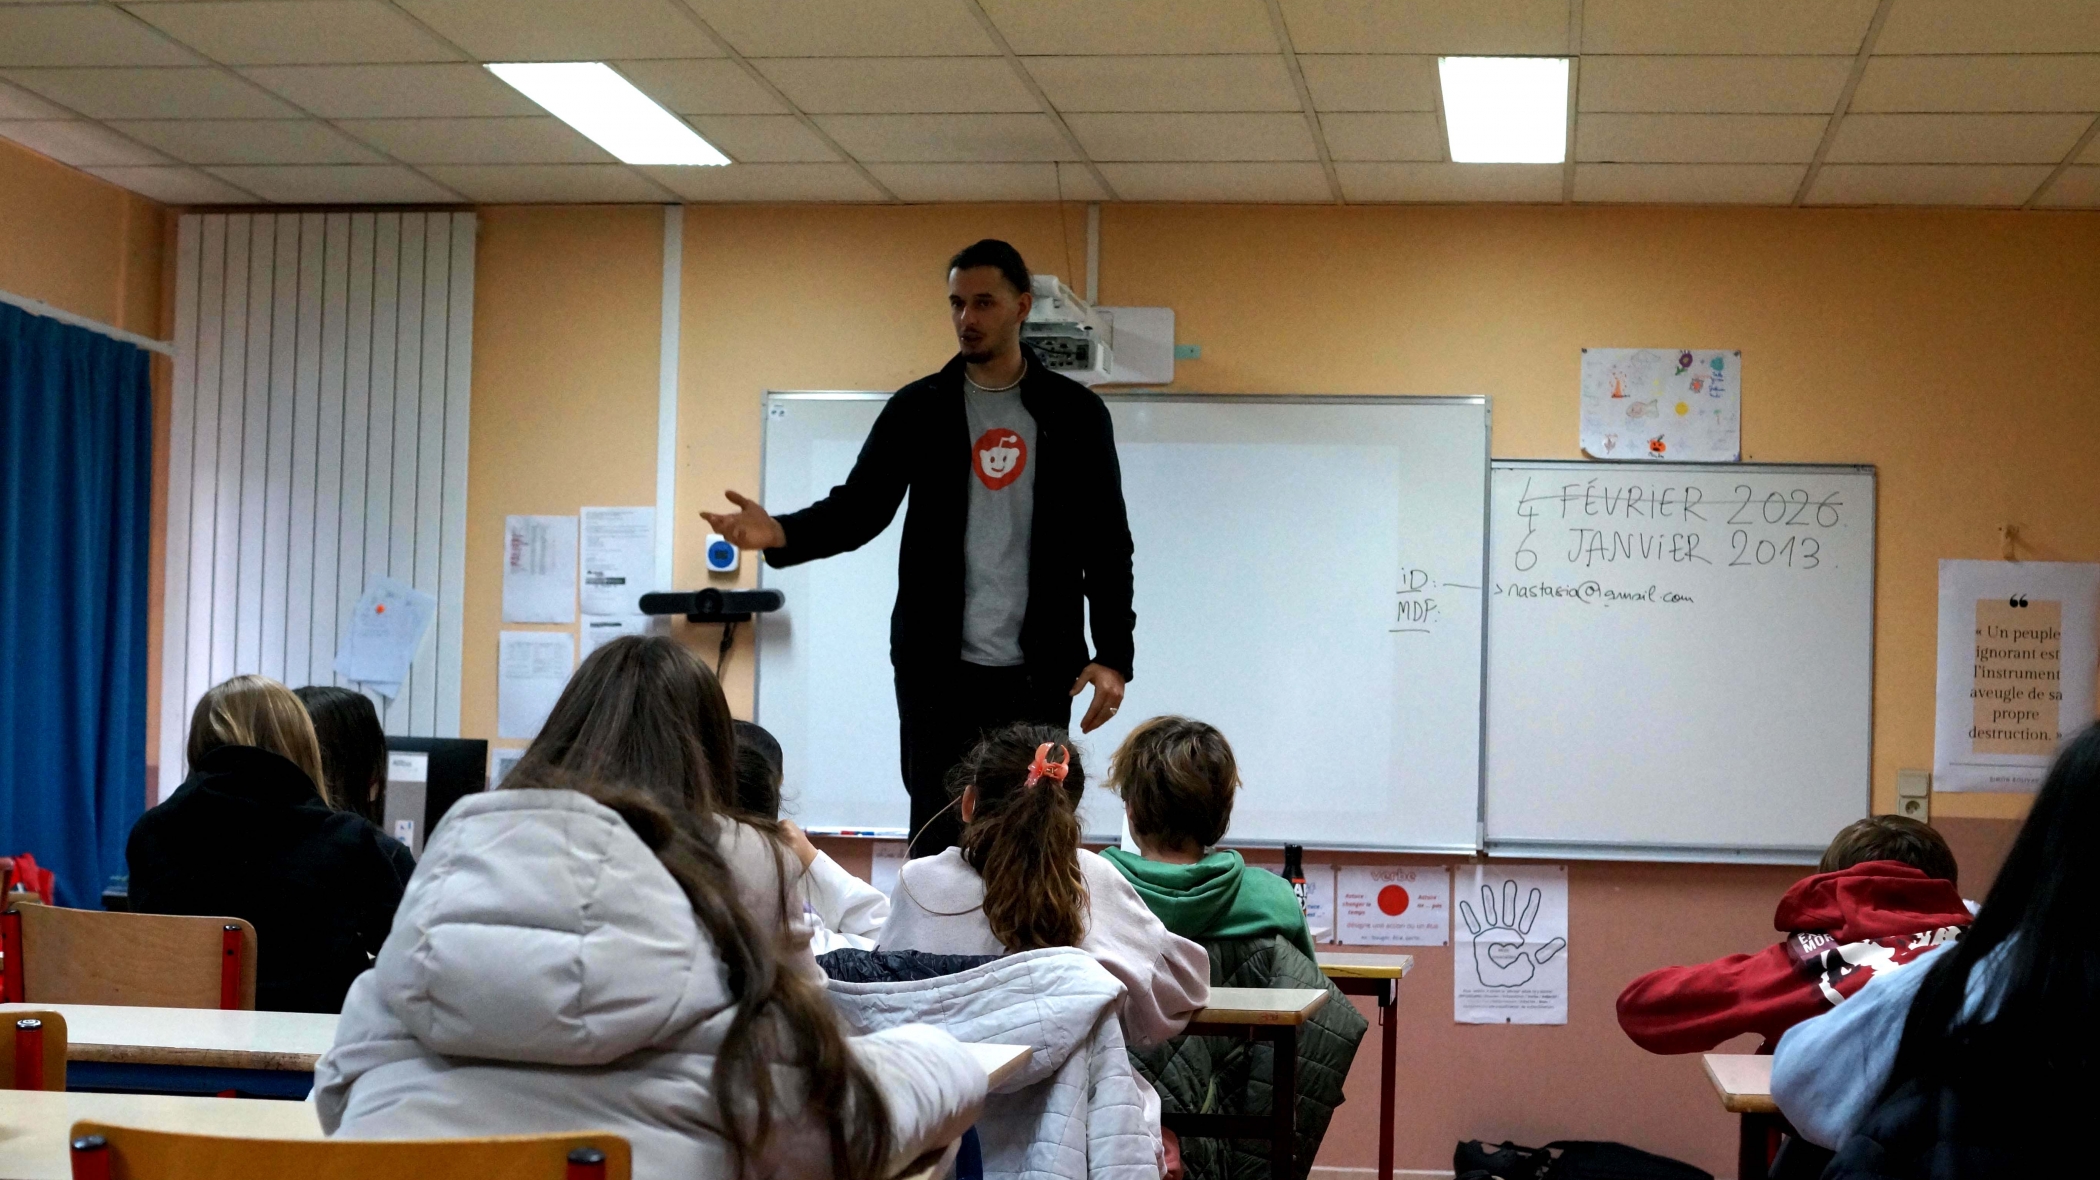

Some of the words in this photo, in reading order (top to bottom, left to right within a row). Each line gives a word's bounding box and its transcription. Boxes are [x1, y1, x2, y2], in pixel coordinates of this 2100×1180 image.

[1517, 476, 1539, 533] 4
[1515, 528, 1538, 572] 6
[1987, 625, 2009, 639] Un
[2013, 626, 2061, 644] peuple
[1976, 645, 2036, 663] ignorant
[2040, 648, 2060, 660] est
[1974, 664, 2061, 681] l'instrument
[1969, 686, 2024, 703] aveugle
[2028, 687, 2045, 700] de
[2048, 691, 2063, 701] sa
[1993, 709, 2040, 724] propre
[1968, 725, 2052, 741] destruction.
